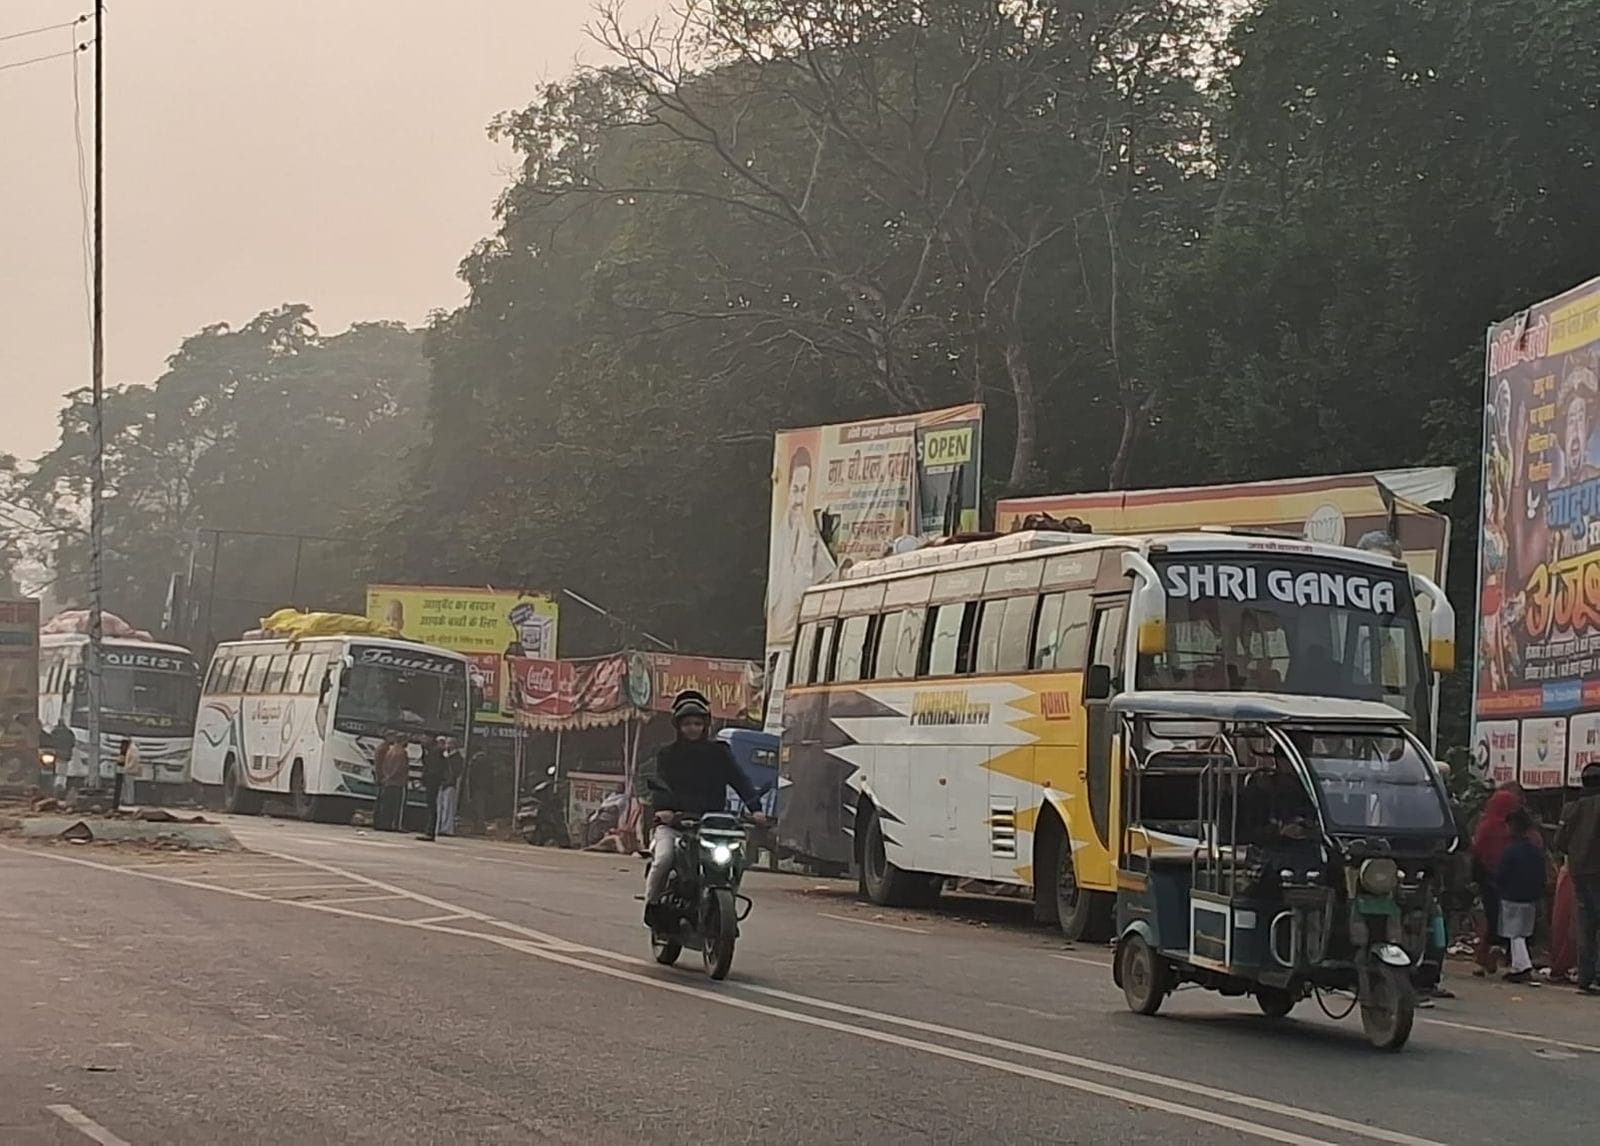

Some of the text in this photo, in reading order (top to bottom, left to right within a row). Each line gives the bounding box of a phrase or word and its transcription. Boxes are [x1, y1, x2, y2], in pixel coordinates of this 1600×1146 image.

[928, 433, 968, 459] OPEN
[1167, 564, 1396, 615] SHRI GANGA
[100, 652, 184, 671] OURIST
[363, 648, 456, 674] Tourist
